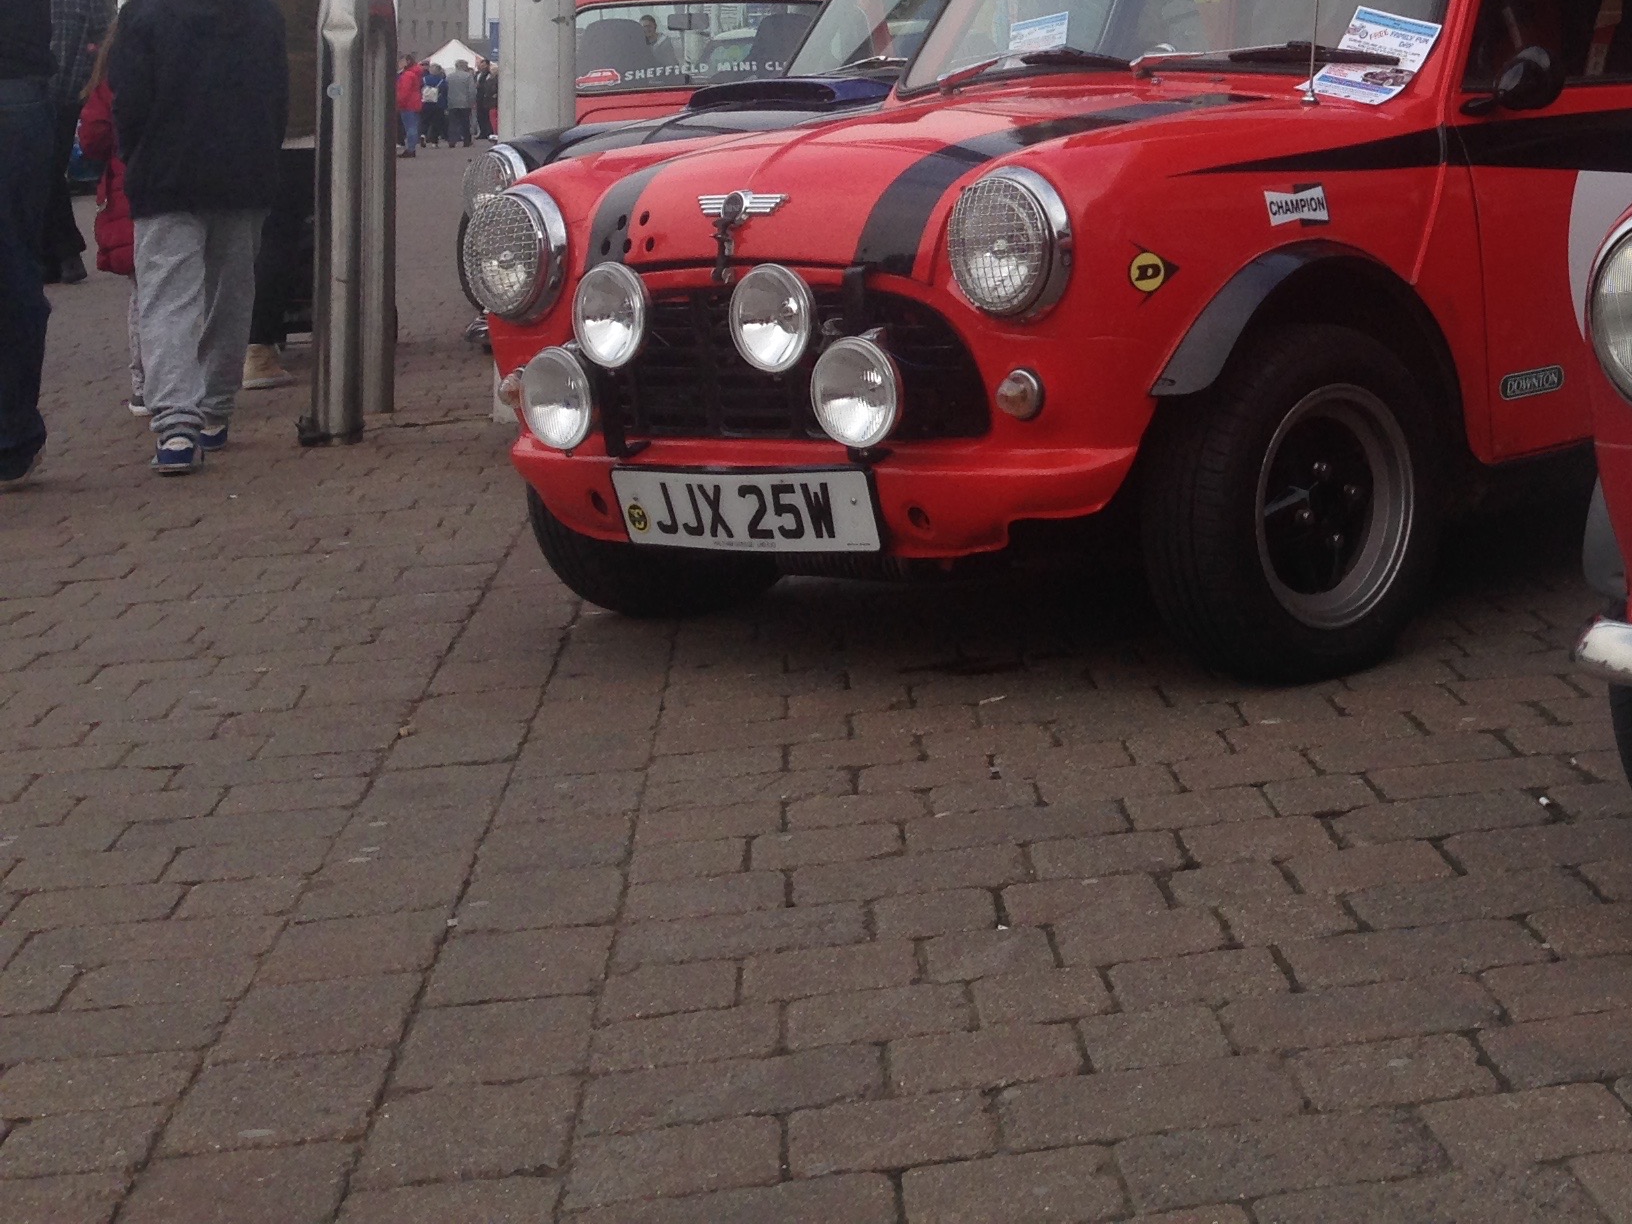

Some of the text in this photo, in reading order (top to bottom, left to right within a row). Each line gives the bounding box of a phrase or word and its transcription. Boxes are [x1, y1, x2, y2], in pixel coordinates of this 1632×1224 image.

[1269, 196, 1326, 216] CHAMPION
[1136, 262, 1161, 281] D
[1506, 369, 1559, 396] DOWNTON
[656, 482, 735, 539] JJX
[736, 482, 837, 540] 25W
